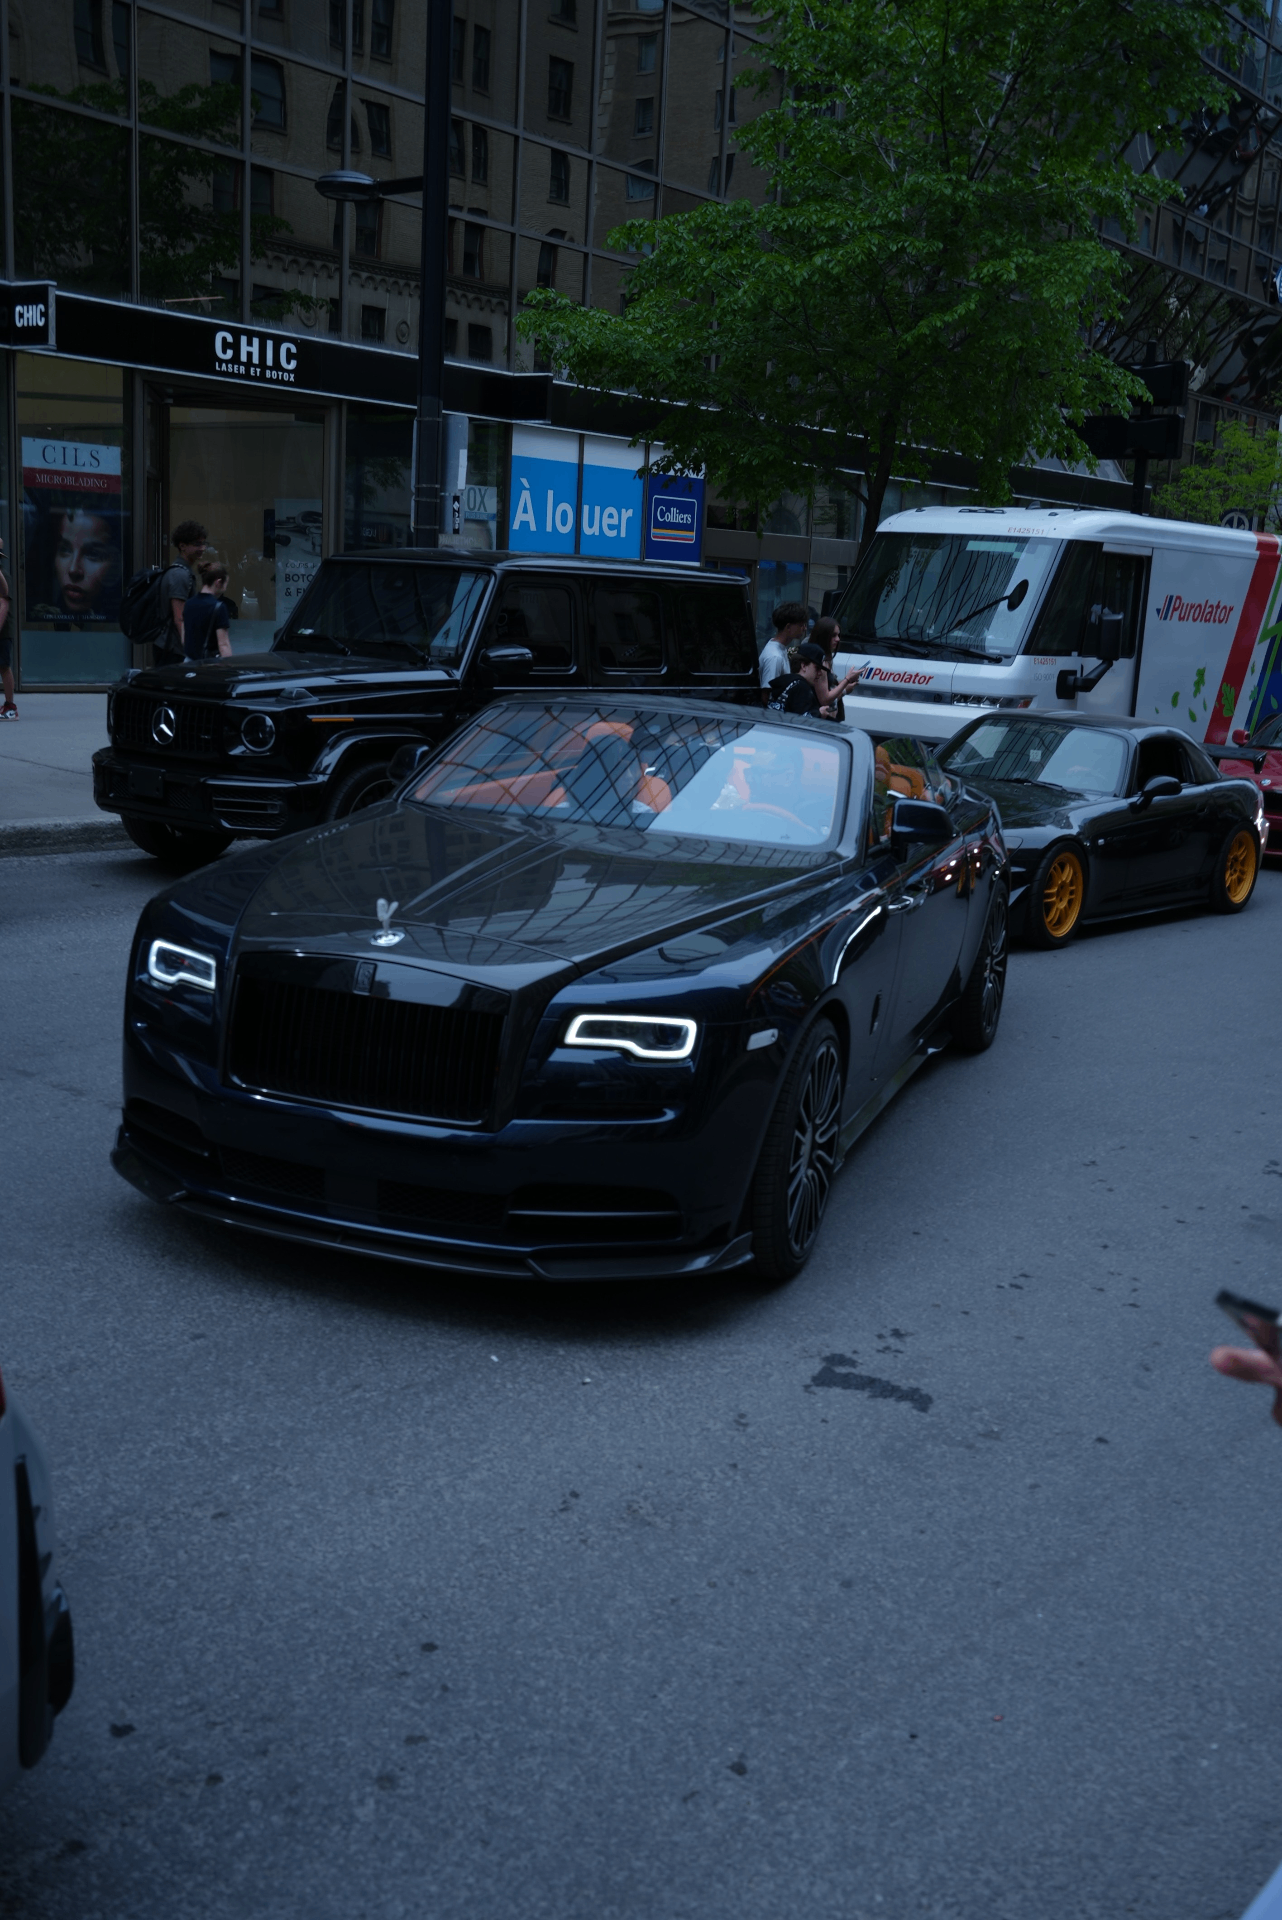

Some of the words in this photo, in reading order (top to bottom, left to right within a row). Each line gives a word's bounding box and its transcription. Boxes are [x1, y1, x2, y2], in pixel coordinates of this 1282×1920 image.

[15, 304, 45, 328] CHIC
[215, 331, 298, 370] CHIC
[215, 361, 246, 375] LASER
[250, 366, 261, 377] ET
[265, 369, 295, 382] BOTOX
[42, 444, 101, 469] CILS
[35, 473, 108, 488] MICROBLADING
[512, 477, 537, 531] À
[546, 489, 633, 538] louer
[657, 506, 692, 524] Colliers
[285, 587, 292, 597] &
[1168, 595, 1234, 624] Purolator
[871, 667, 934, 685] Purolator
